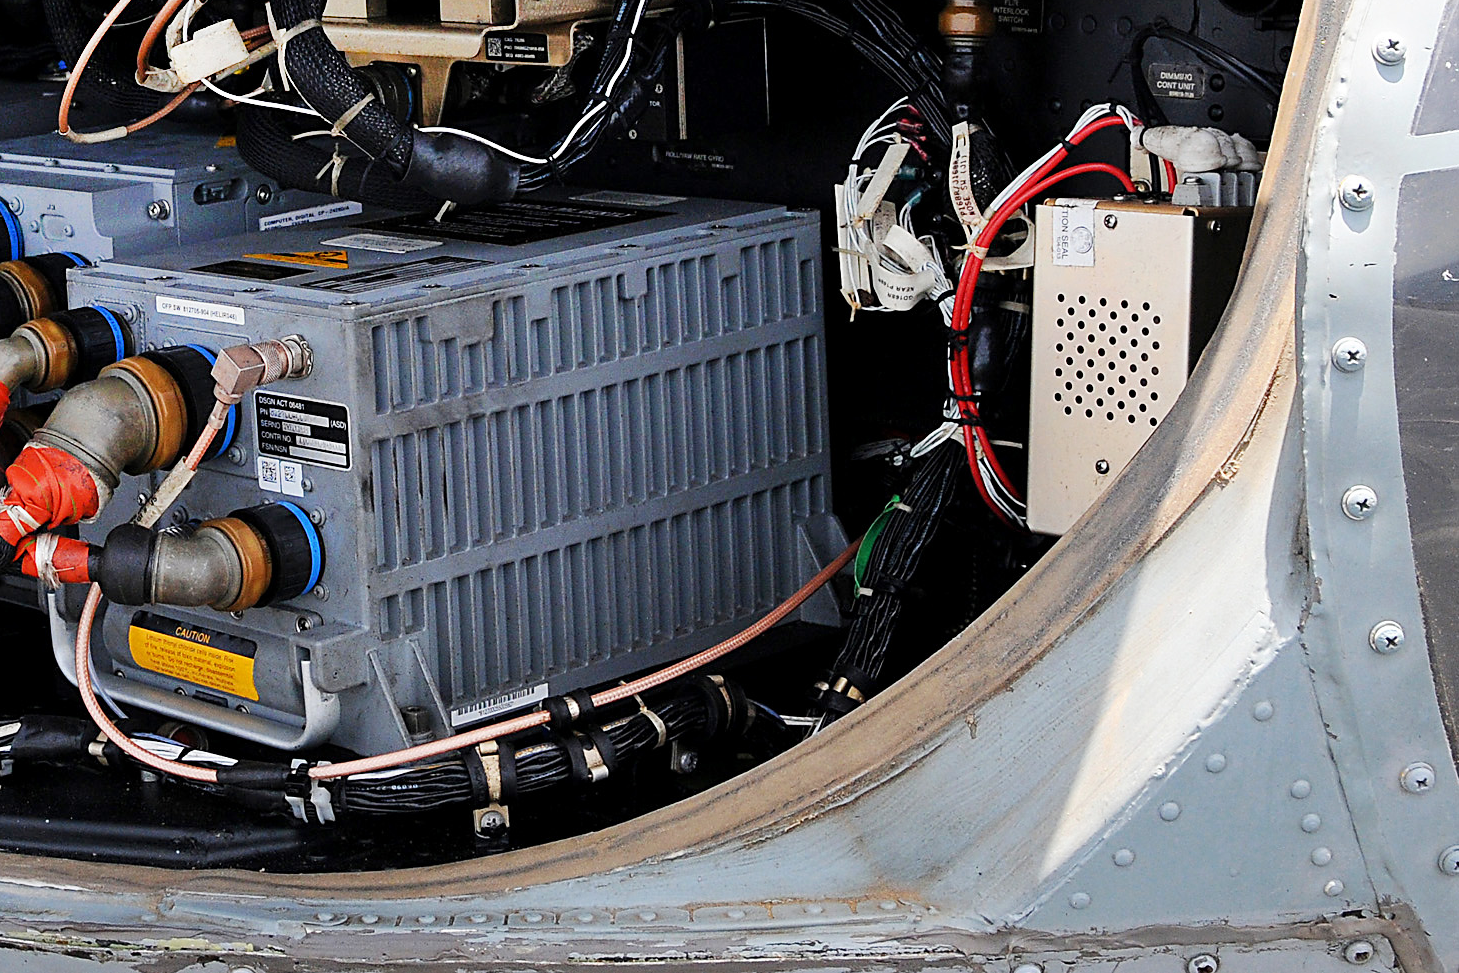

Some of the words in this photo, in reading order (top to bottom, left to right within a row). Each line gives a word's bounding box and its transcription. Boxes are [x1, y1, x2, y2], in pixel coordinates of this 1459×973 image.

[1161, 72, 1193, 81] DIMMING
[1157, 81, 1177, 89] CONT
[1178, 82, 1195, 90] UNIT
[963, 196, 976, 216] NOSE
[1061, 236, 1069, 259] SEAL
[259, 396, 275, 405] DSGN
[175, 627, 211, 644] CAUTION
